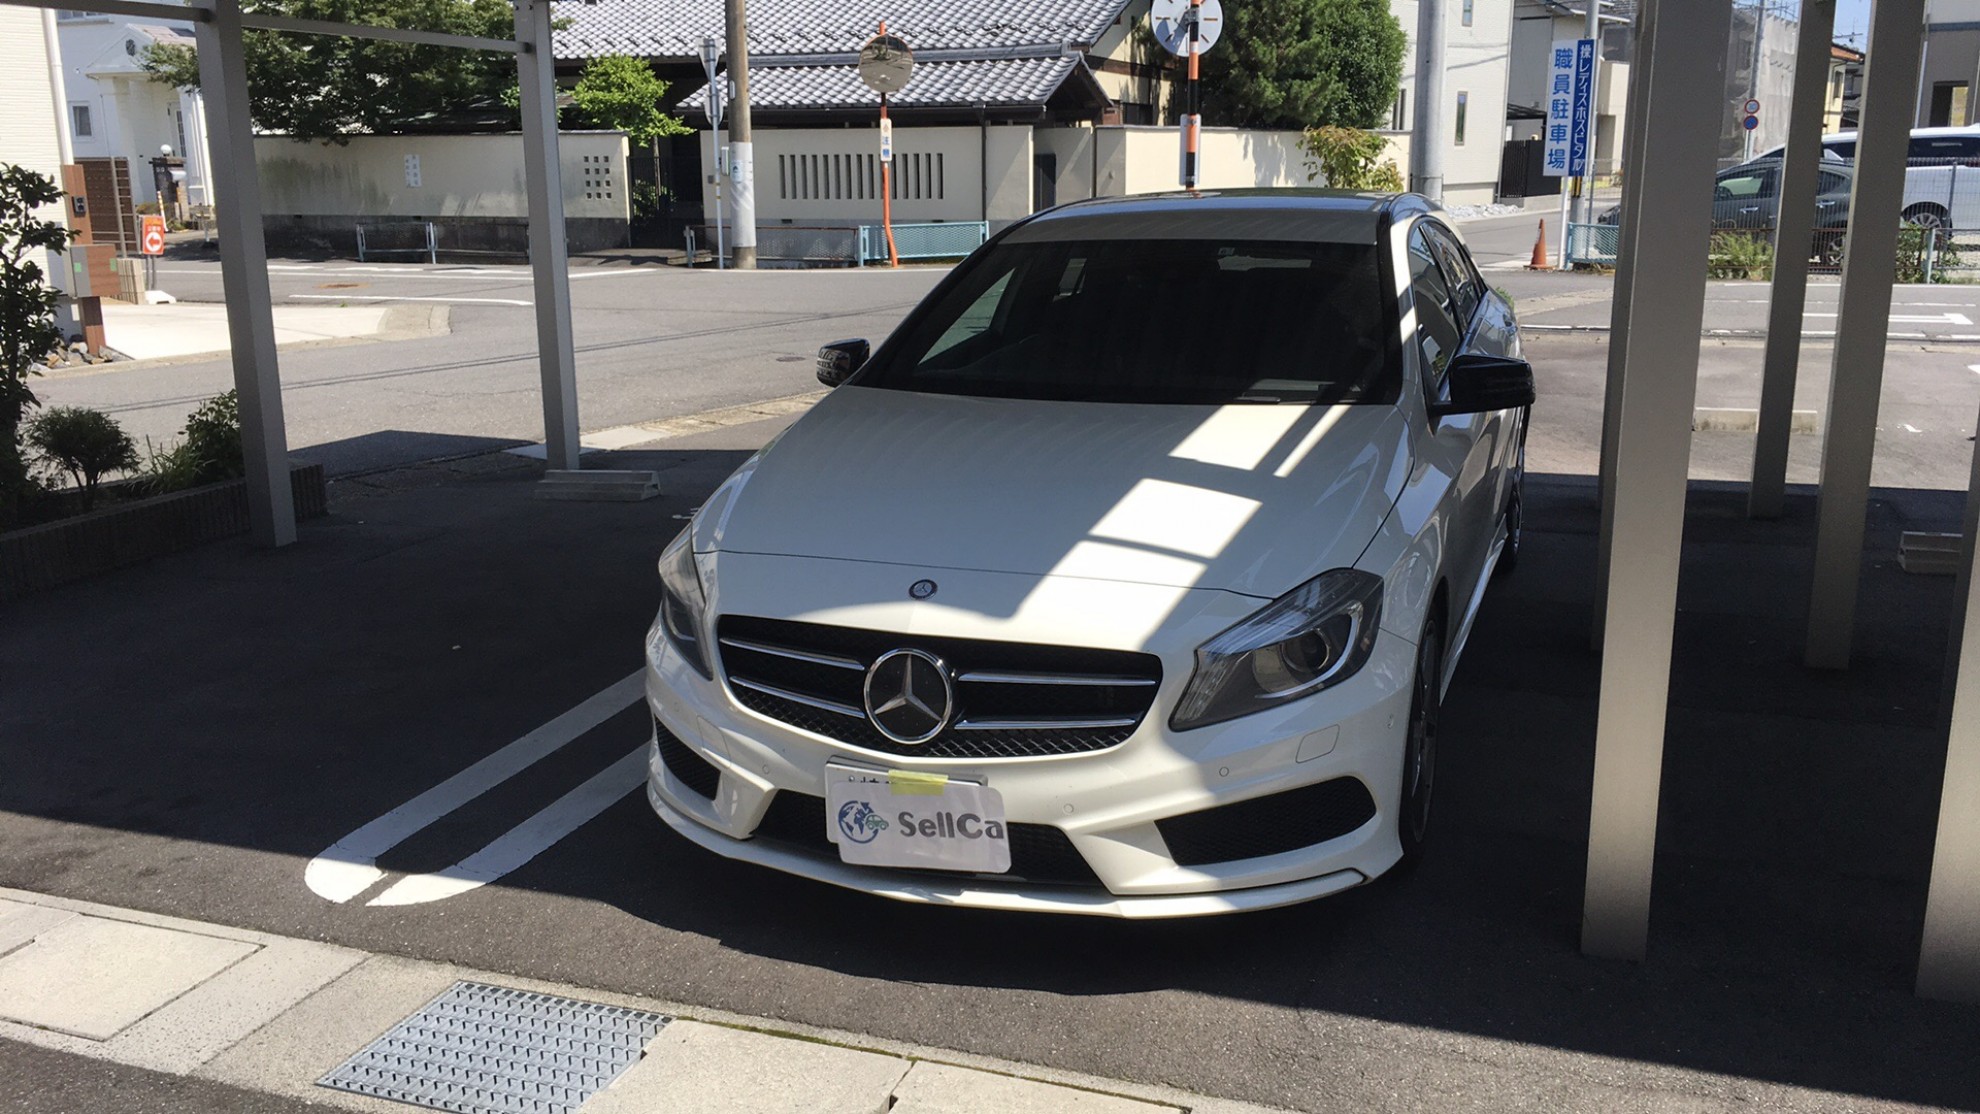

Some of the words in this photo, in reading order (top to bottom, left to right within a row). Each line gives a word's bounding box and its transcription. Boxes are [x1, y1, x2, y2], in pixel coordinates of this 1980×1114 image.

[1547, 47, 1574, 170] 職員駐車場
[898, 811, 1004, 840] SellCa
